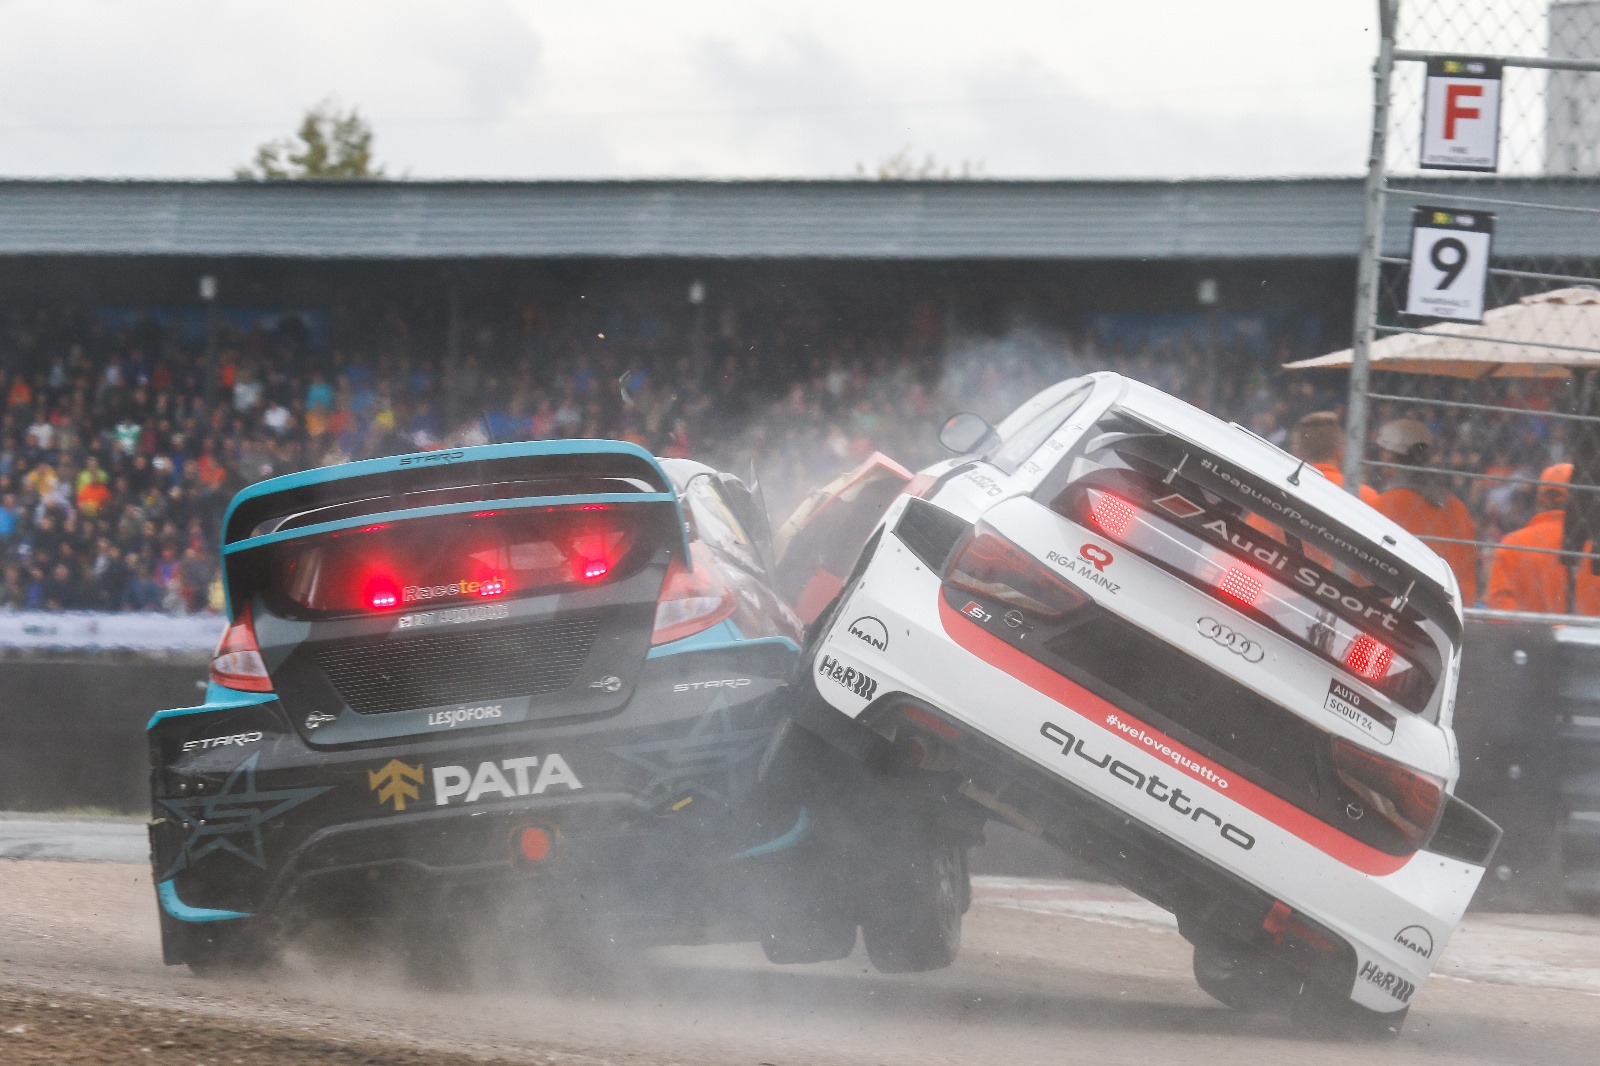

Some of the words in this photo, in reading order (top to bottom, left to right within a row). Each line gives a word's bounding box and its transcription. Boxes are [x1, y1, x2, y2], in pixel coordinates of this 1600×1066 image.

[1442, 84, 1484, 140] F
[1430, 236, 1468, 291] 9
[399, 451, 465, 466] STARD
[1200, 459, 1399, 577] #LeagueofPerformance
[1045, 550, 1076, 571] RIGA
[1077, 568, 1121, 595] MAINZ
[1202, 519, 1289, 571] Audi
[1295, 567, 1399, 631] Sport
[969, 607, 993, 623] S1
[851, 626, 885, 651] MAN
[673, 678, 752, 693] STARD
[819, 654, 858, 692] H&R
[1333, 684, 1360, 706] AUTO
[1329, 698, 1362, 722] SCOUT
[1361, 717, 1373, 731] 24
[182, 731, 263, 752] STARD
[1106, 713, 1229, 790] #welovequattro
[432, 753, 584, 806] PATA
[1039, 721, 1256, 851] quattro
[1396, 935, 1428, 957] MAN
[1359, 960, 1397, 993] H&R
